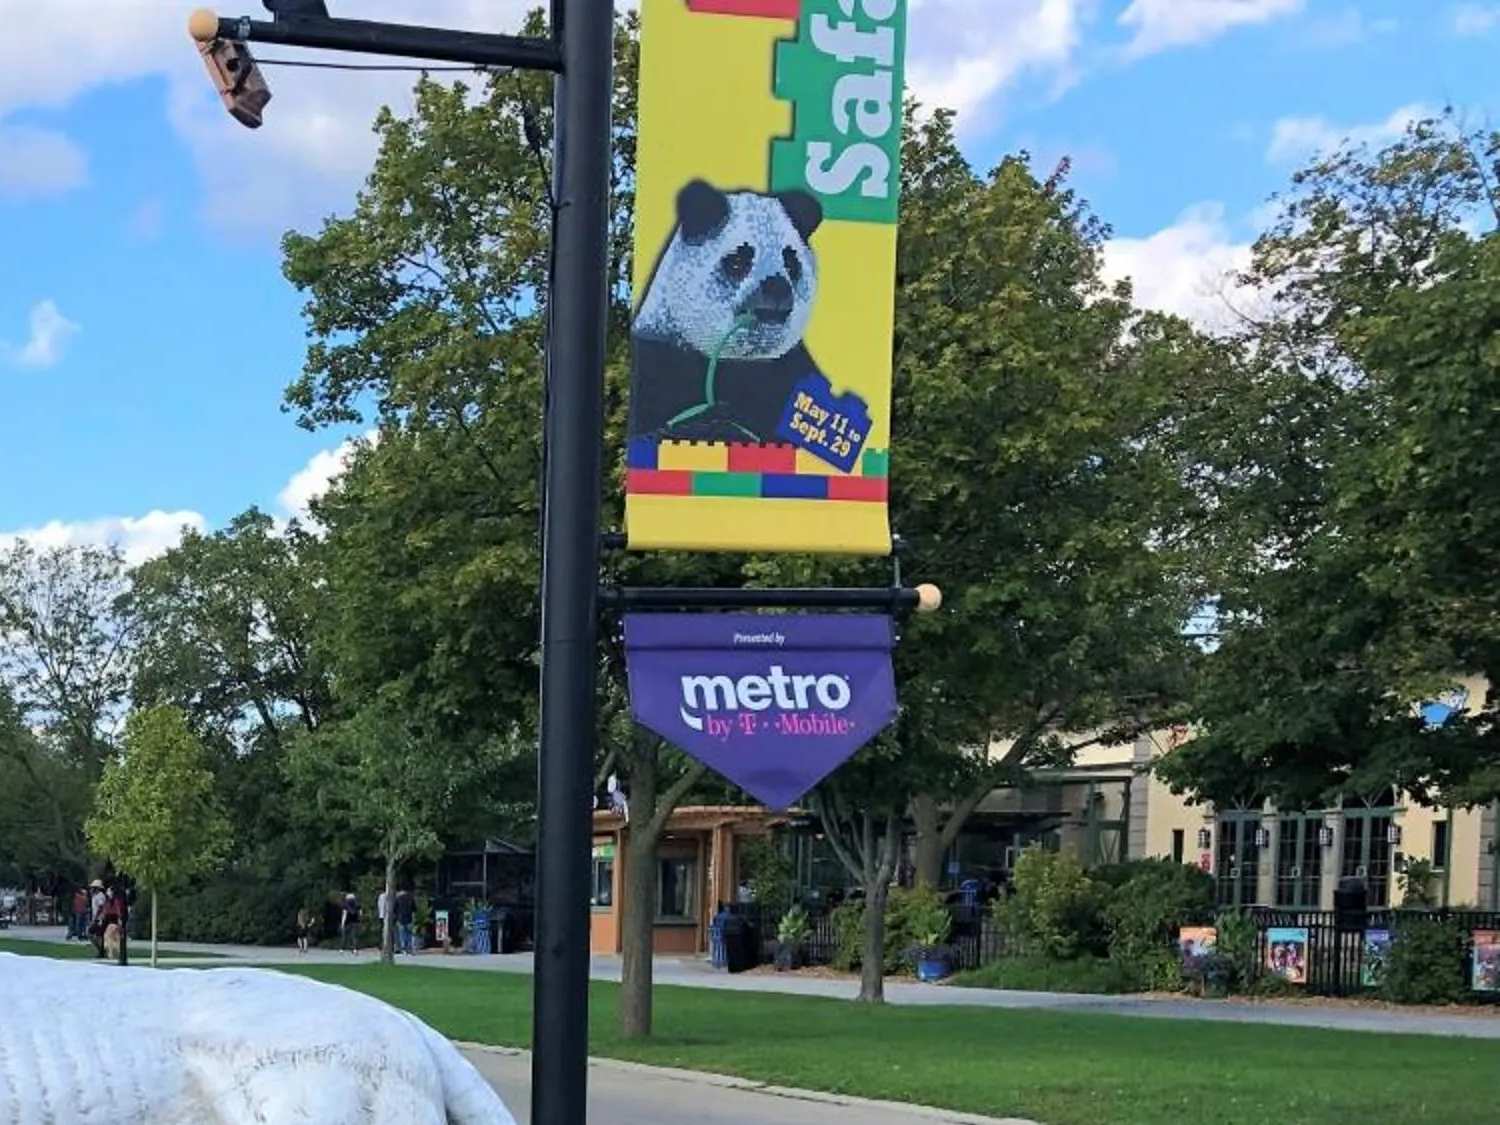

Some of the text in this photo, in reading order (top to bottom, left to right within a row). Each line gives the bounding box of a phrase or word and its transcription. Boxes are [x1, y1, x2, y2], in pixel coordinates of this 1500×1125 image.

[789, 411, 851, 457] Sept. 29
[793, 391, 861, 442] May 11 to
[733, 632, 786, 647] Presented by
[680, 665, 851, 712] metro
[707, 713, 733, 742] by
